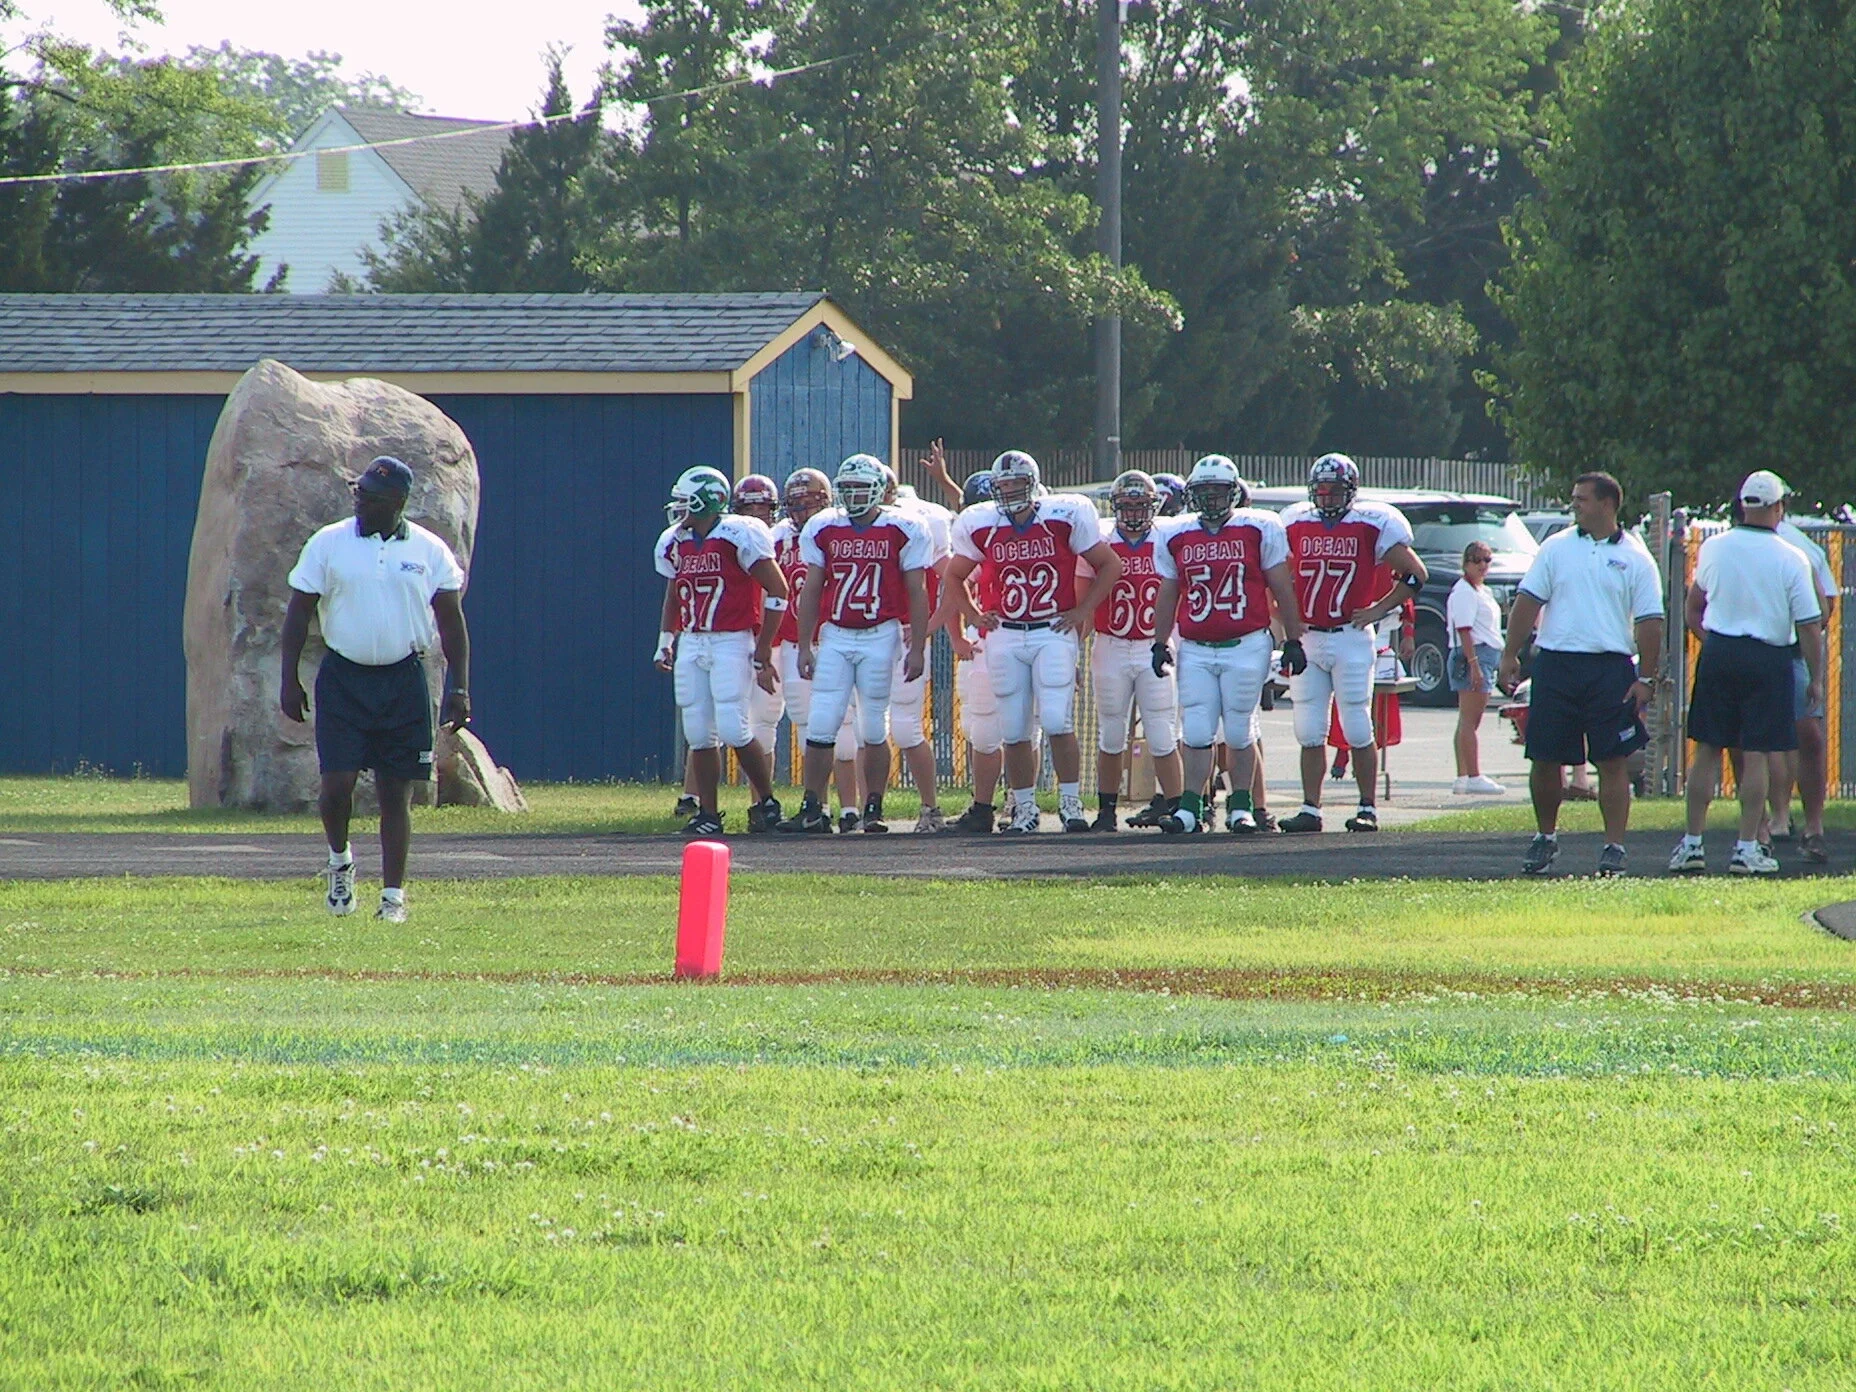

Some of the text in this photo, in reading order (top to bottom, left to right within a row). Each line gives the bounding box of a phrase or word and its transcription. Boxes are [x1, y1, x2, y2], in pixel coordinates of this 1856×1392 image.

[829, 539, 889, 560] OCEAN
[992, 536, 1056, 563] OCEAN
[1119, 556, 1155, 576] CEA
[1182, 540, 1245, 564] OCEAN
[1301, 535, 1358, 557] OCEAN
[831, 562, 882, 621] 74
[1000, 561, 1059, 620] 62
[1107, 577, 1163, 637] 68
[1185, 562, 1247, 623] 54
[1299, 559, 1357, 619] 77
